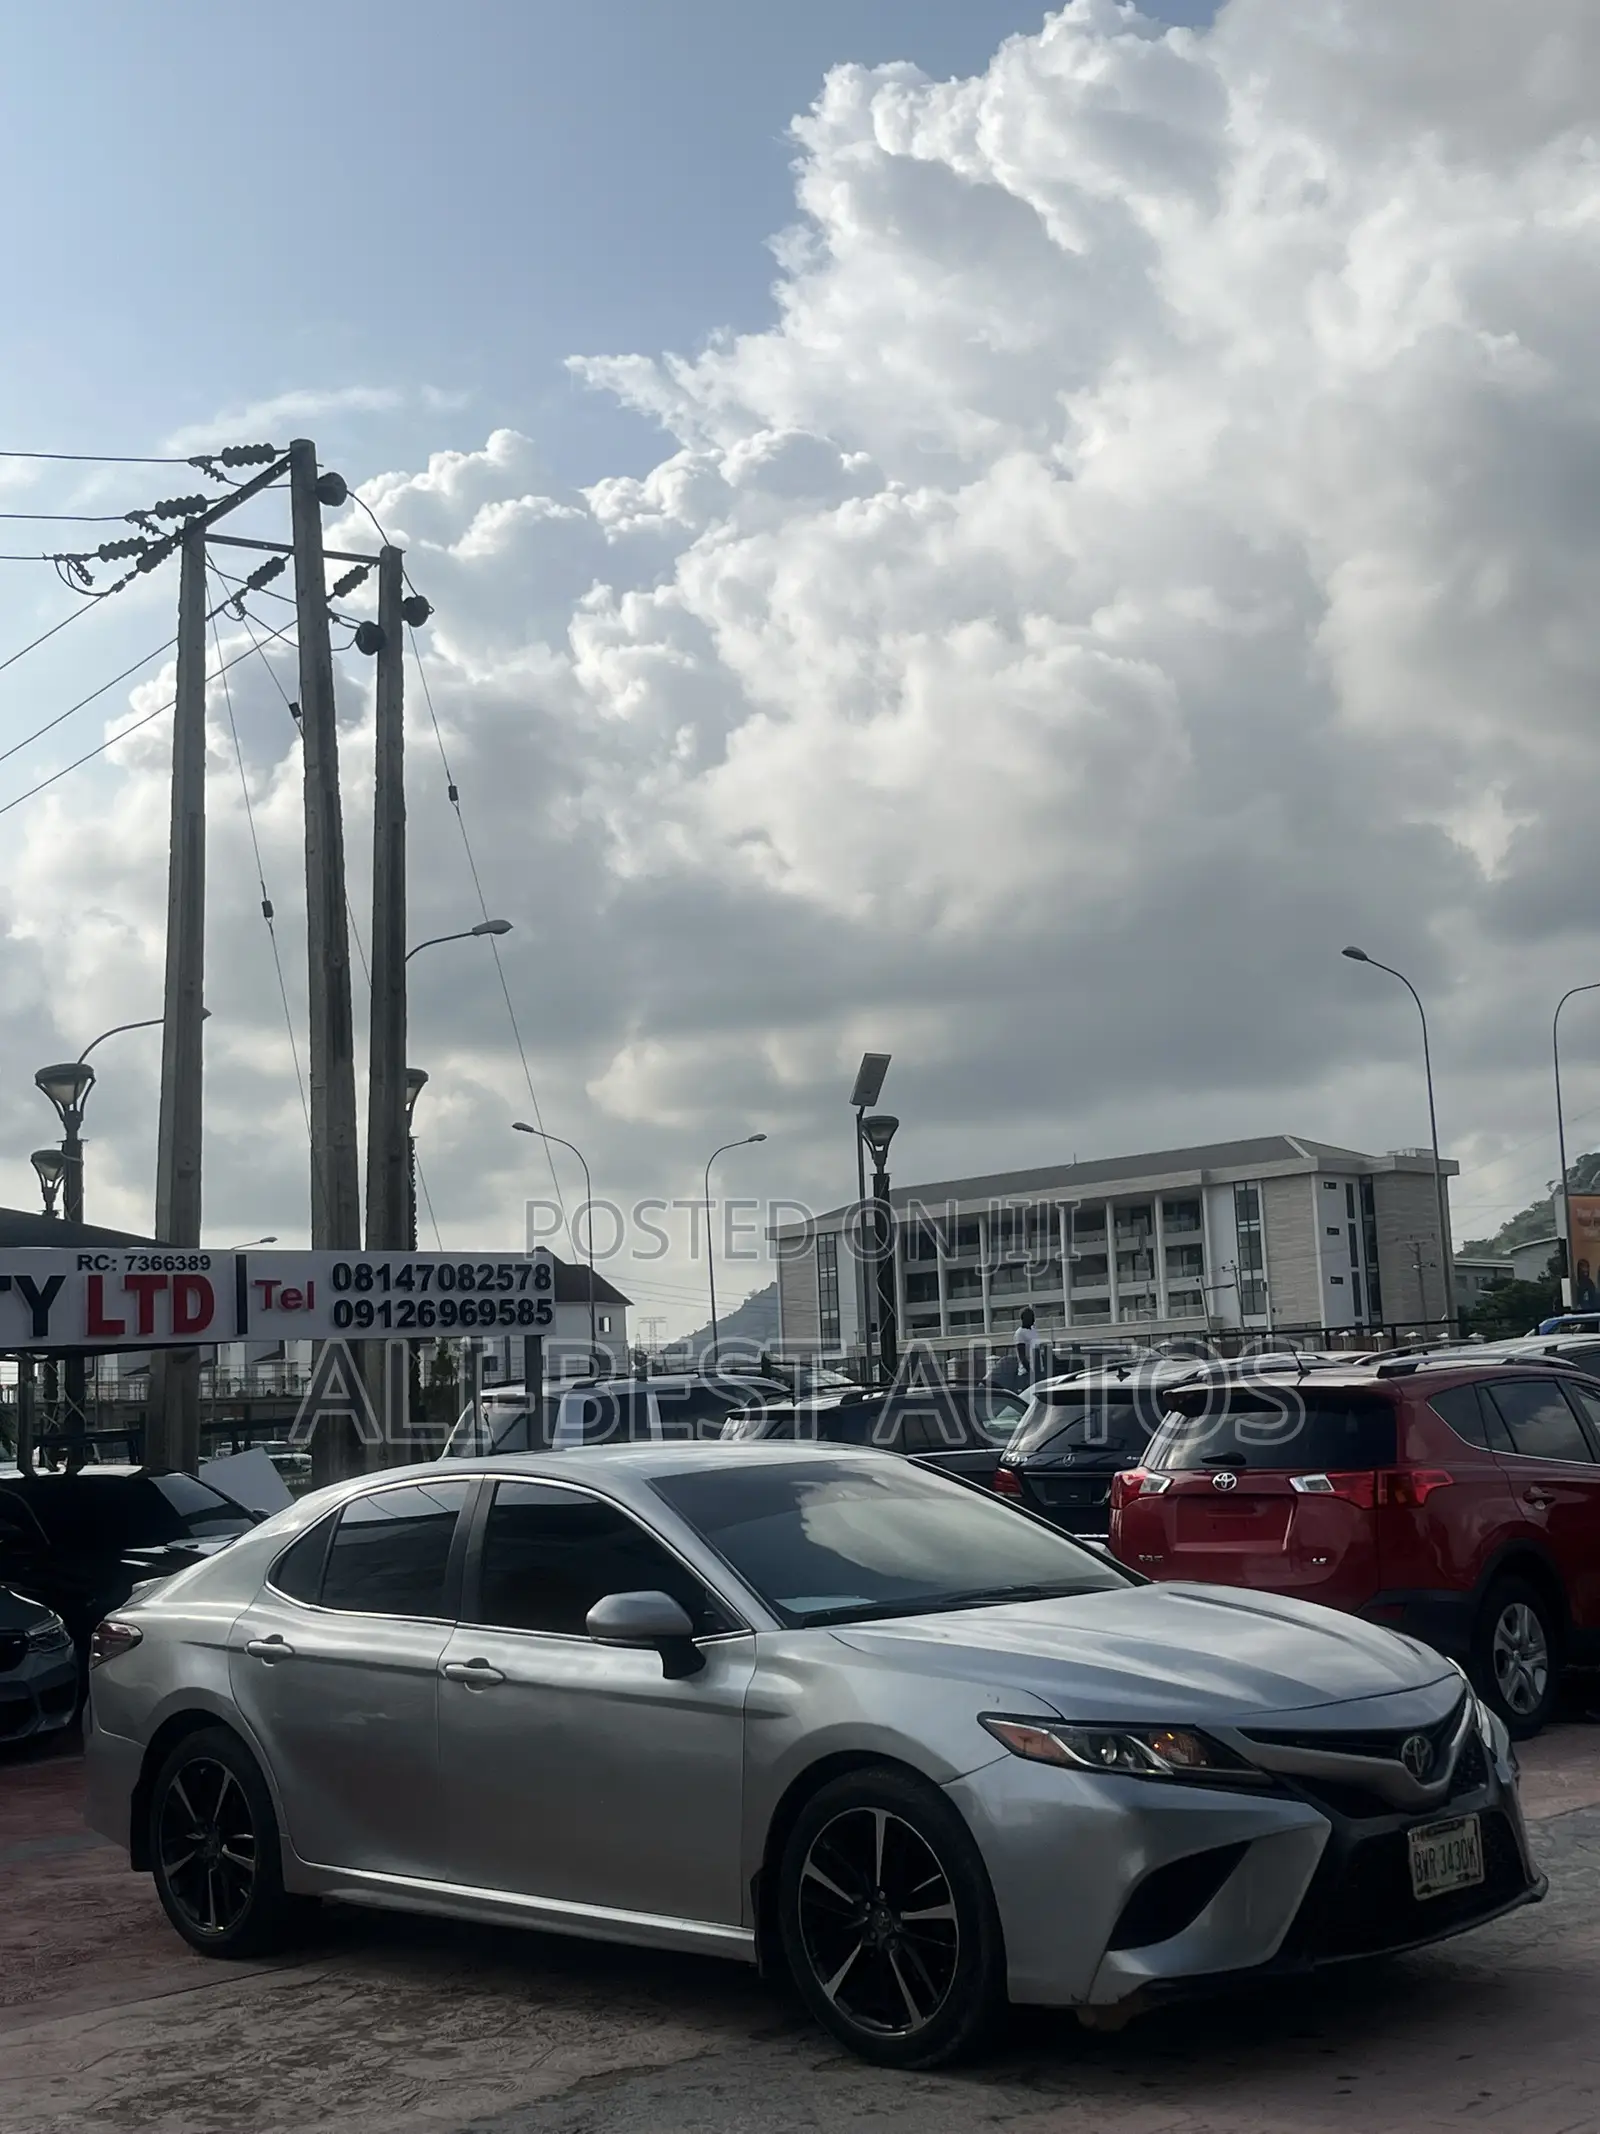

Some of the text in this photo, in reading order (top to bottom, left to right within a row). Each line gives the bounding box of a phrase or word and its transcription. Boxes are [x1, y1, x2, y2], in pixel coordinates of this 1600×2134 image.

[77, 1255, 211, 1271] RC: 7366389
[332, 1263, 552, 1292] 08147082578
[87, 1275, 215, 1336] LTD
[254, 1280, 315, 1310] Tel
[333, 1299, 553, 1328] 09126969585
